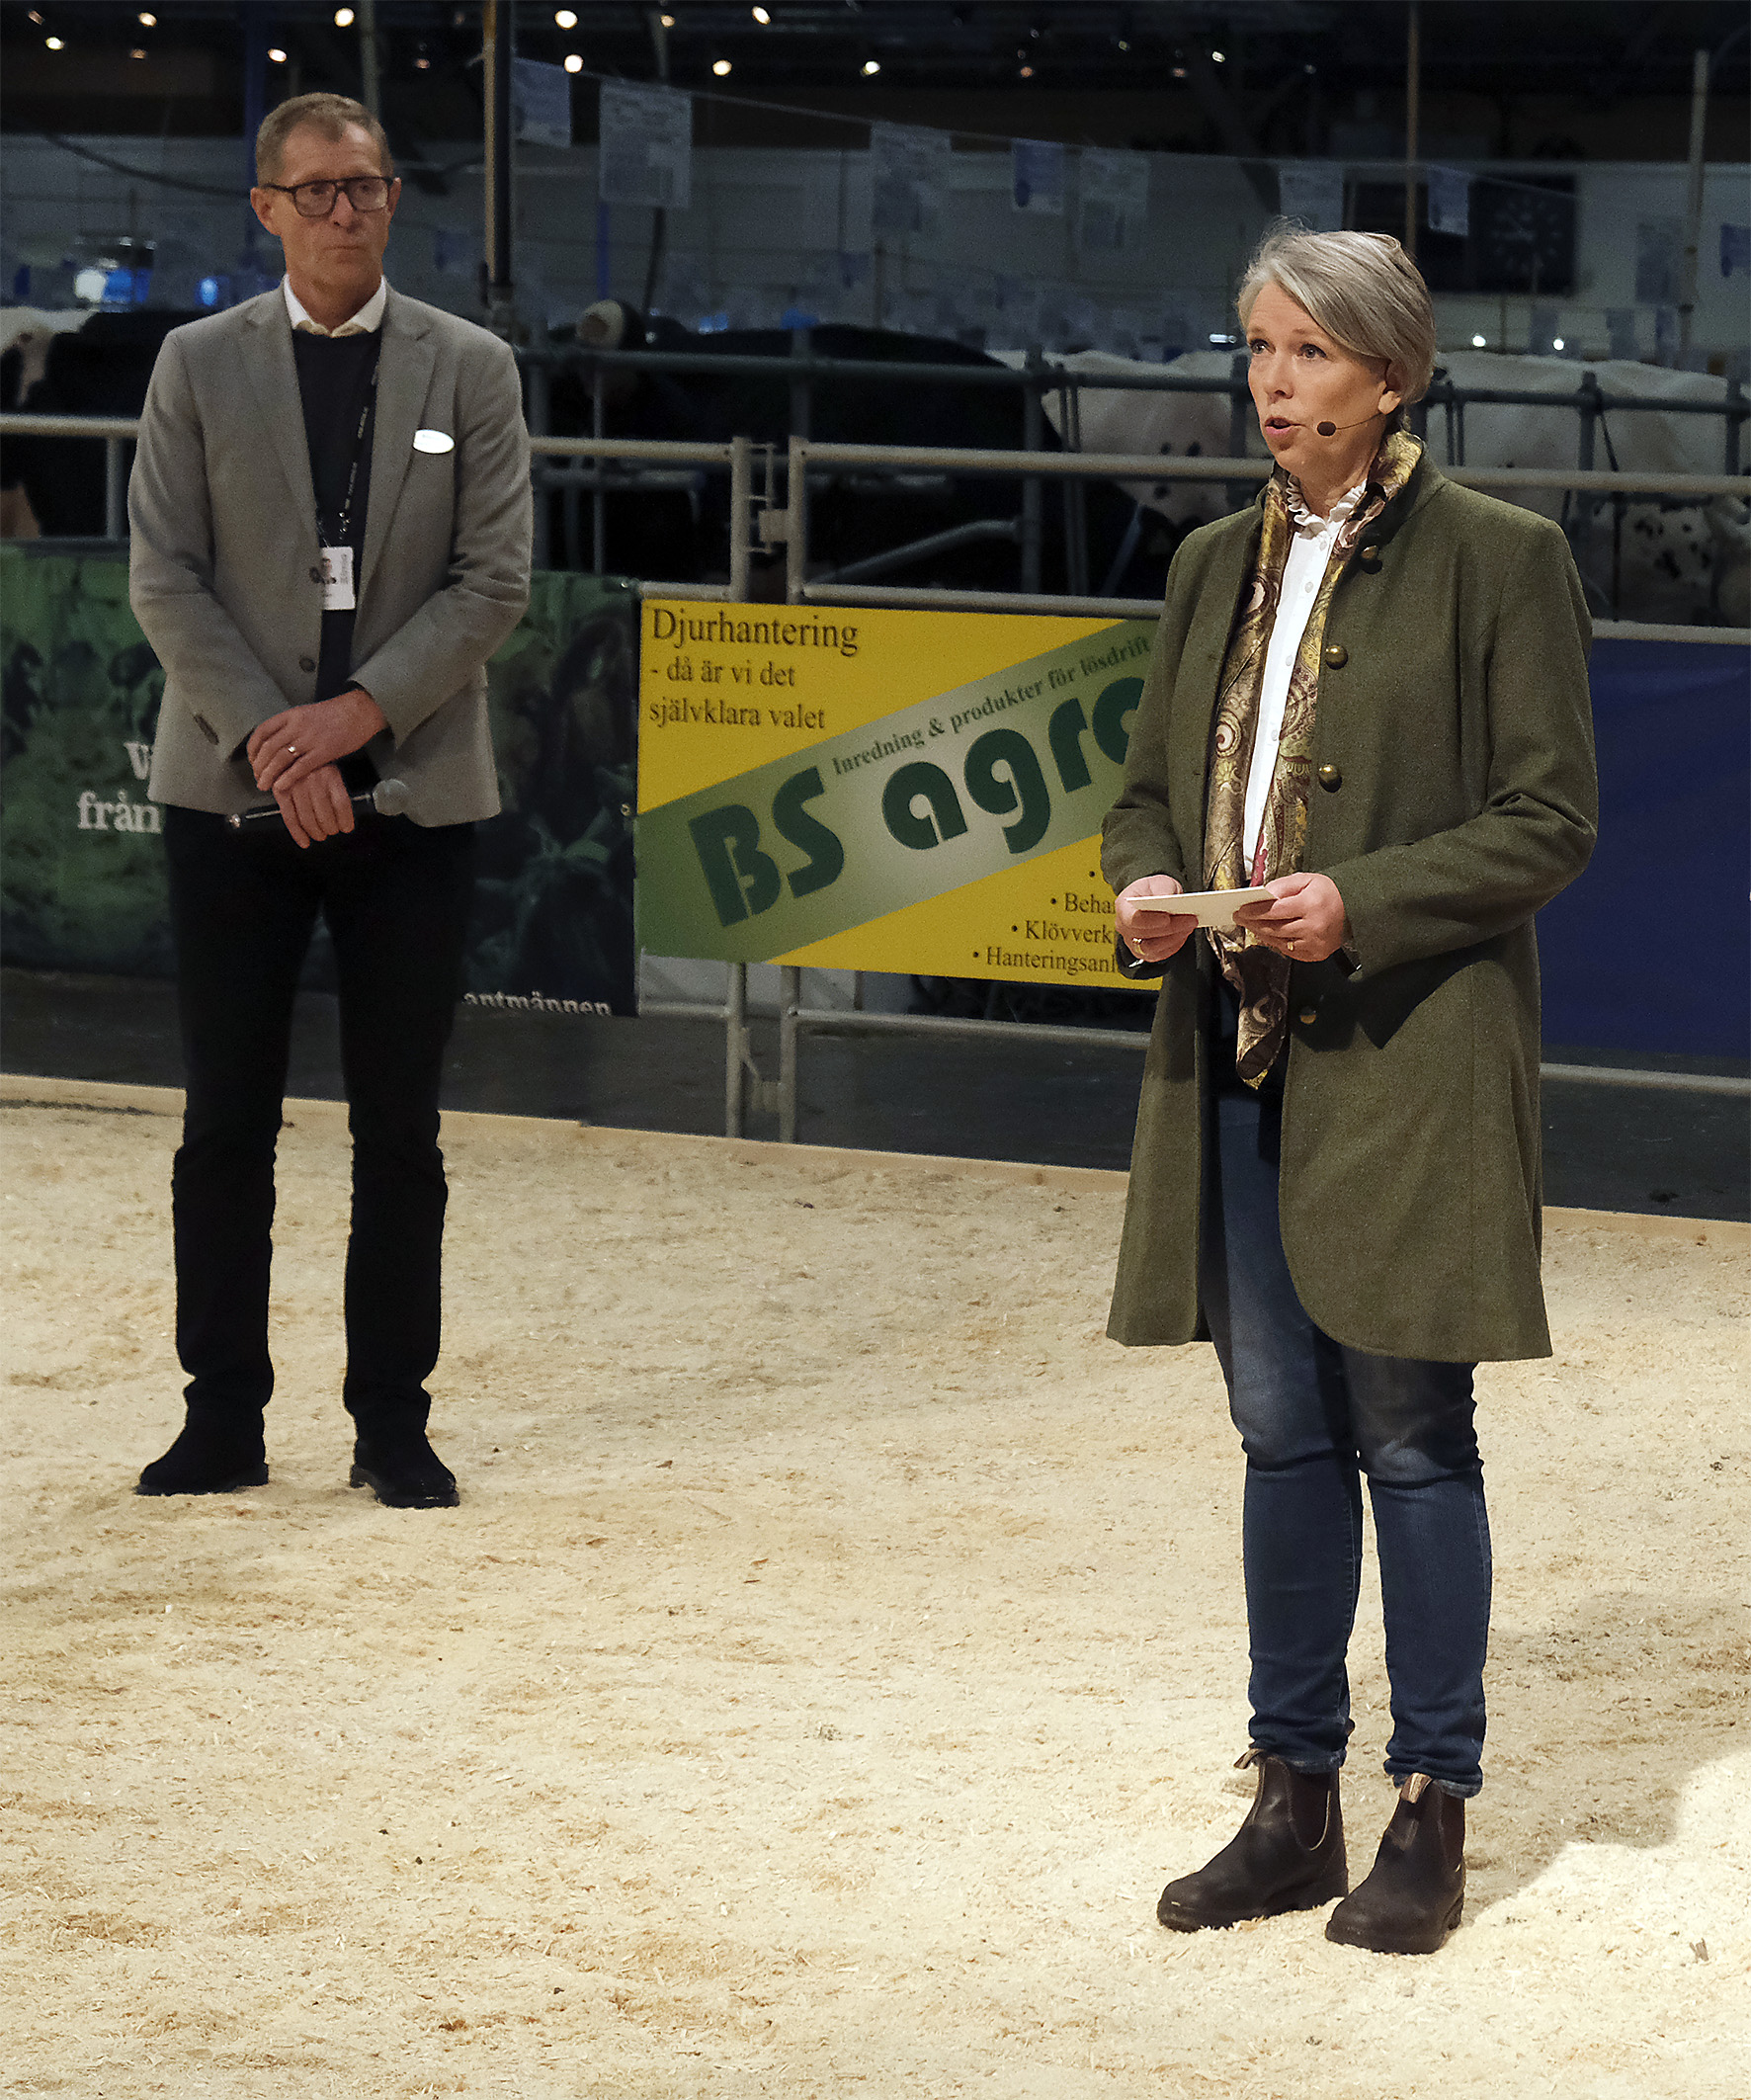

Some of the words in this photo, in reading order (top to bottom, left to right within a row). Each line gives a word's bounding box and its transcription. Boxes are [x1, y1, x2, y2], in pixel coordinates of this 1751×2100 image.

[653, 608, 858, 657] Djurhantering
[666, 655, 693, 682] då
[701, 660, 723, 684] är
[731, 659, 751, 685] vi
[759, 661, 795, 687] det
[649, 696, 761, 728] självklara
[768, 703, 826, 729] valet
[832, 729, 927, 776] Inredning
[927, 717, 945, 738] &
[950, 678, 1043, 735] produkter
[1046, 663, 1076, 692] för
[1080, 636, 1152, 677] lösdrift
[76, 788, 163, 834] från
[689, 765, 845, 927] BS
[1025, 920, 1115, 945] Klövverk
[986, 946, 1117, 976] Hanteringsanl
[462, 990, 613, 1017] antmännen
